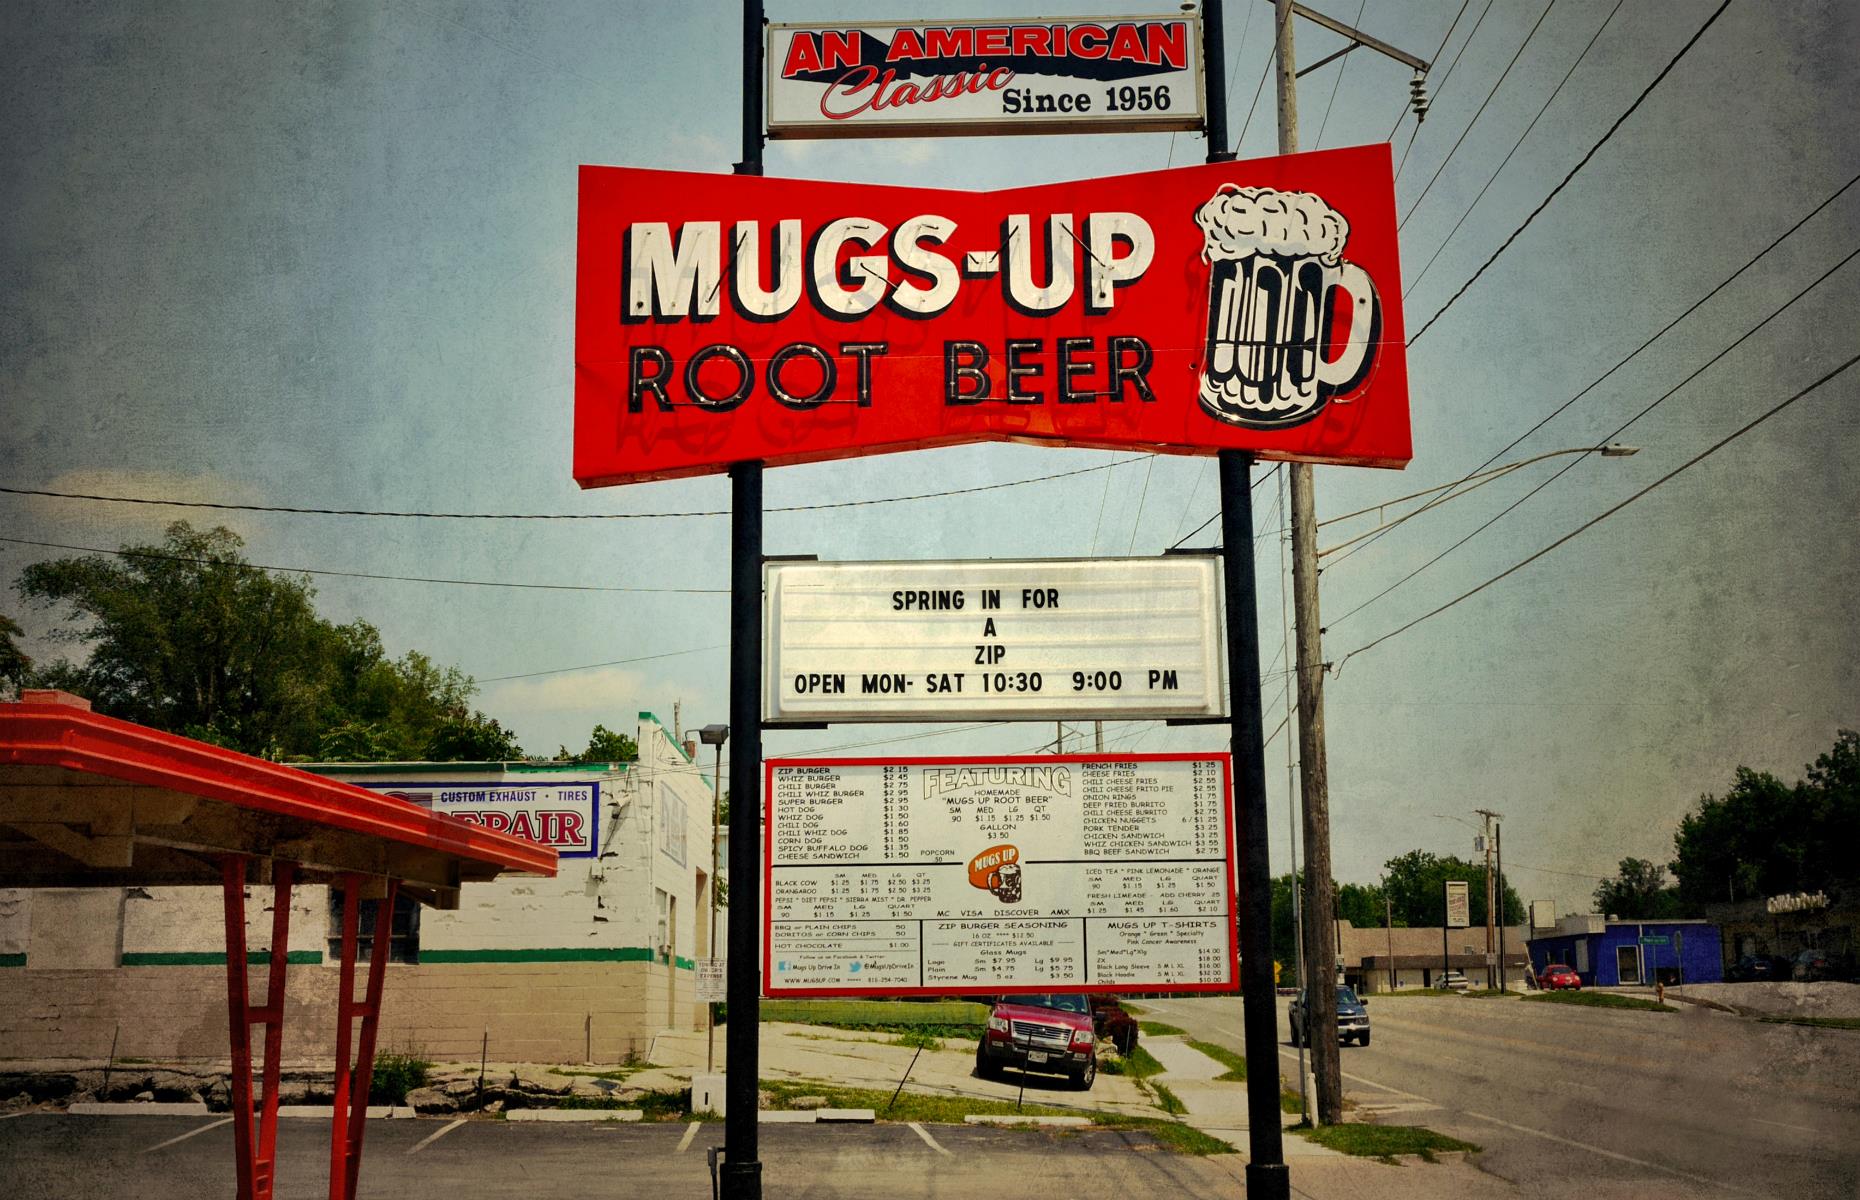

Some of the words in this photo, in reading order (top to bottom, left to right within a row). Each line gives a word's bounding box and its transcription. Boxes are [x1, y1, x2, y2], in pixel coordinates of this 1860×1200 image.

[781, 30, 861, 78] AN
[885, 23, 1187, 70] AMERICAN
[820, 64, 1015, 120] Classic
[1002, 88, 1091, 113] Since
[1106, 86, 1170, 111] 1956
[621, 212, 1156, 324] MUGS-UP
[629, 342, 888, 412] ROOT
[944, 337, 1156, 405] BEER
[893, 590, 965, 610] SPRING
[982, 590, 1000, 609] IN
[1022, 589, 1058, 608] FOR
[984, 618, 996, 637] A
[975, 646, 1005, 664] ZIP
[794, 674, 845, 693] OPEN
[862, 673, 913, 693] MON-
[927, 673, 964, 692] SAT
[982, 672, 1043, 692] 10:30
[1073, 671, 1122, 690] 9:00
[1149, 670, 1178, 690] PM
[441, 792, 486, 802] CUSTOM
[489, 792, 536, 801] EXHAUST
[558, 791, 587, 800] TIRES
[924, 766, 1071, 800] FEATURING
[439, 810, 586, 846] PAIR
[975, 852, 1000, 872] MUGS
[1003, 848, 1015, 861] UP
